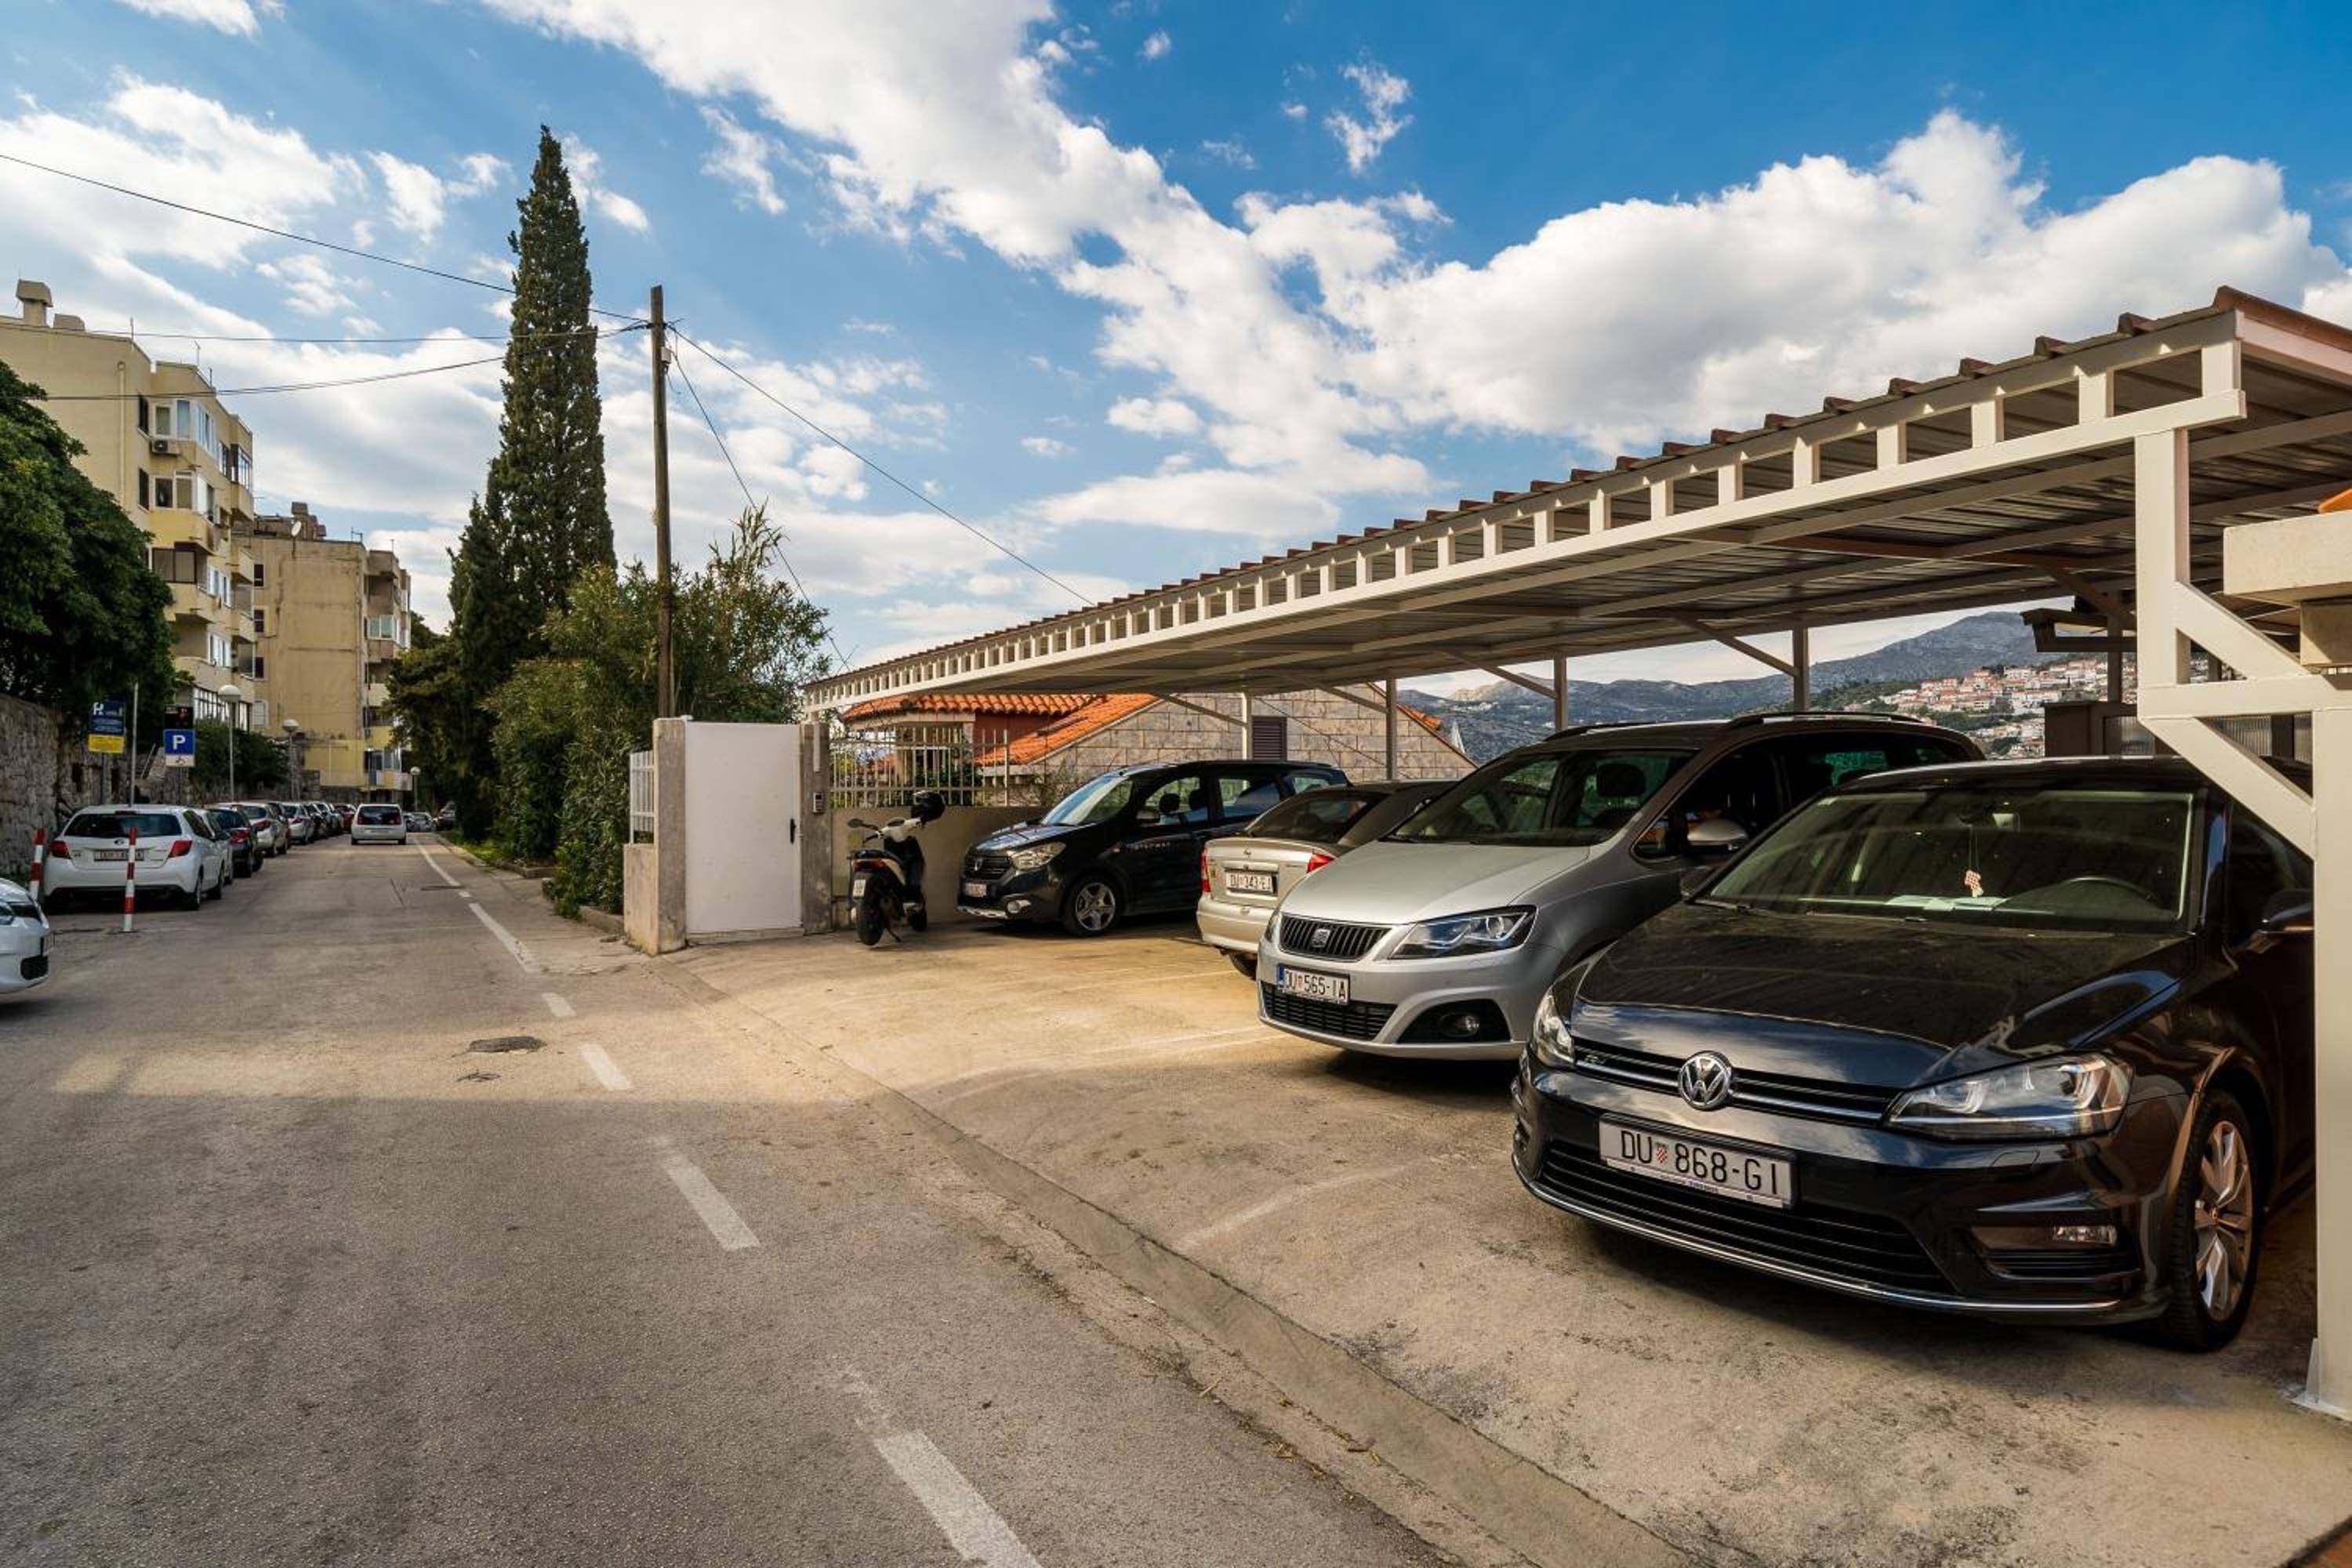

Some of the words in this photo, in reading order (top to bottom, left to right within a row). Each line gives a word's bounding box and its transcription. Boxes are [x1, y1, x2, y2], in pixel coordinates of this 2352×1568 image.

[172, 735, 186, 750] P
[1304, 975, 1346, 1000] 565-IA
[1621, 1130, 1653, 1163] DU
[1675, 1142, 1777, 1195] 868-GI
